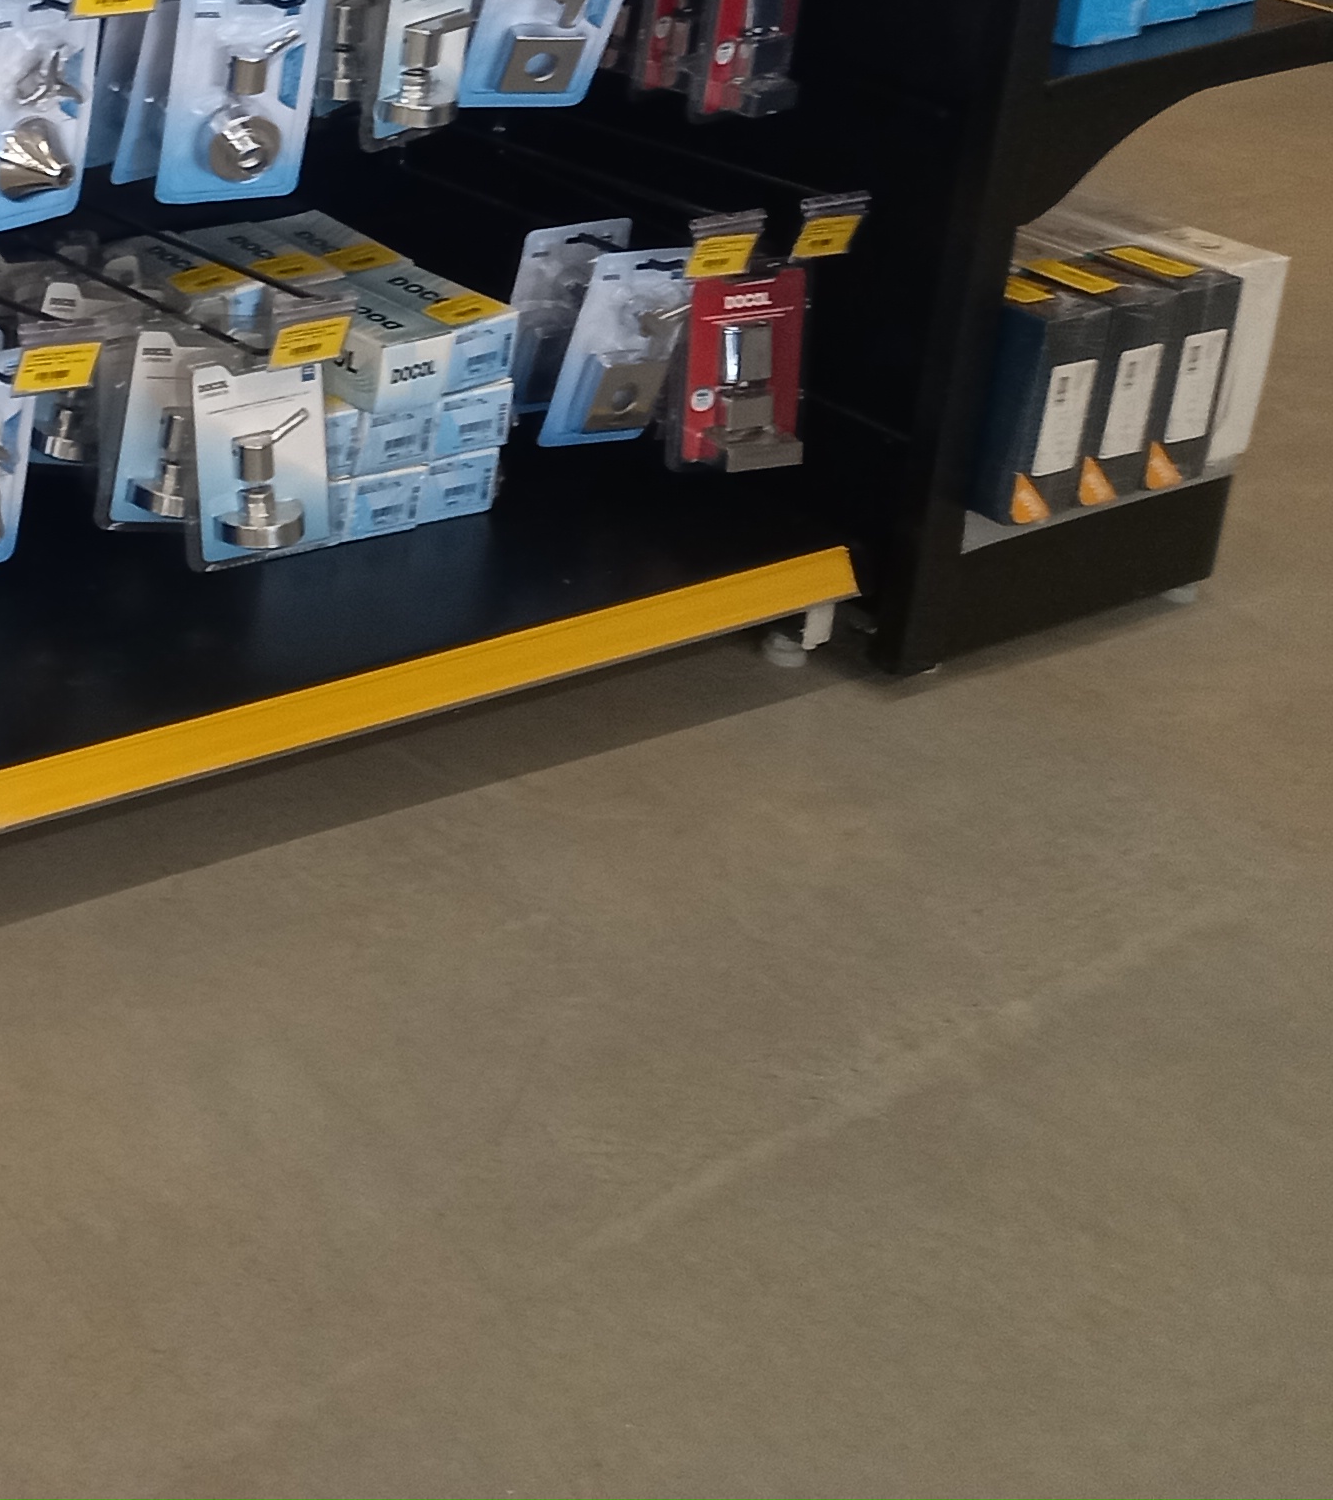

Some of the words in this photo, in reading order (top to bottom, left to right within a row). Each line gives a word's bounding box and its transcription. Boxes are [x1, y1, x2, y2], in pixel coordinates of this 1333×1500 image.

[387, 276, 451, 304] DOC
[723, 292, 773, 310] DOCOL
[390, 360, 437, 385] DOCOL
